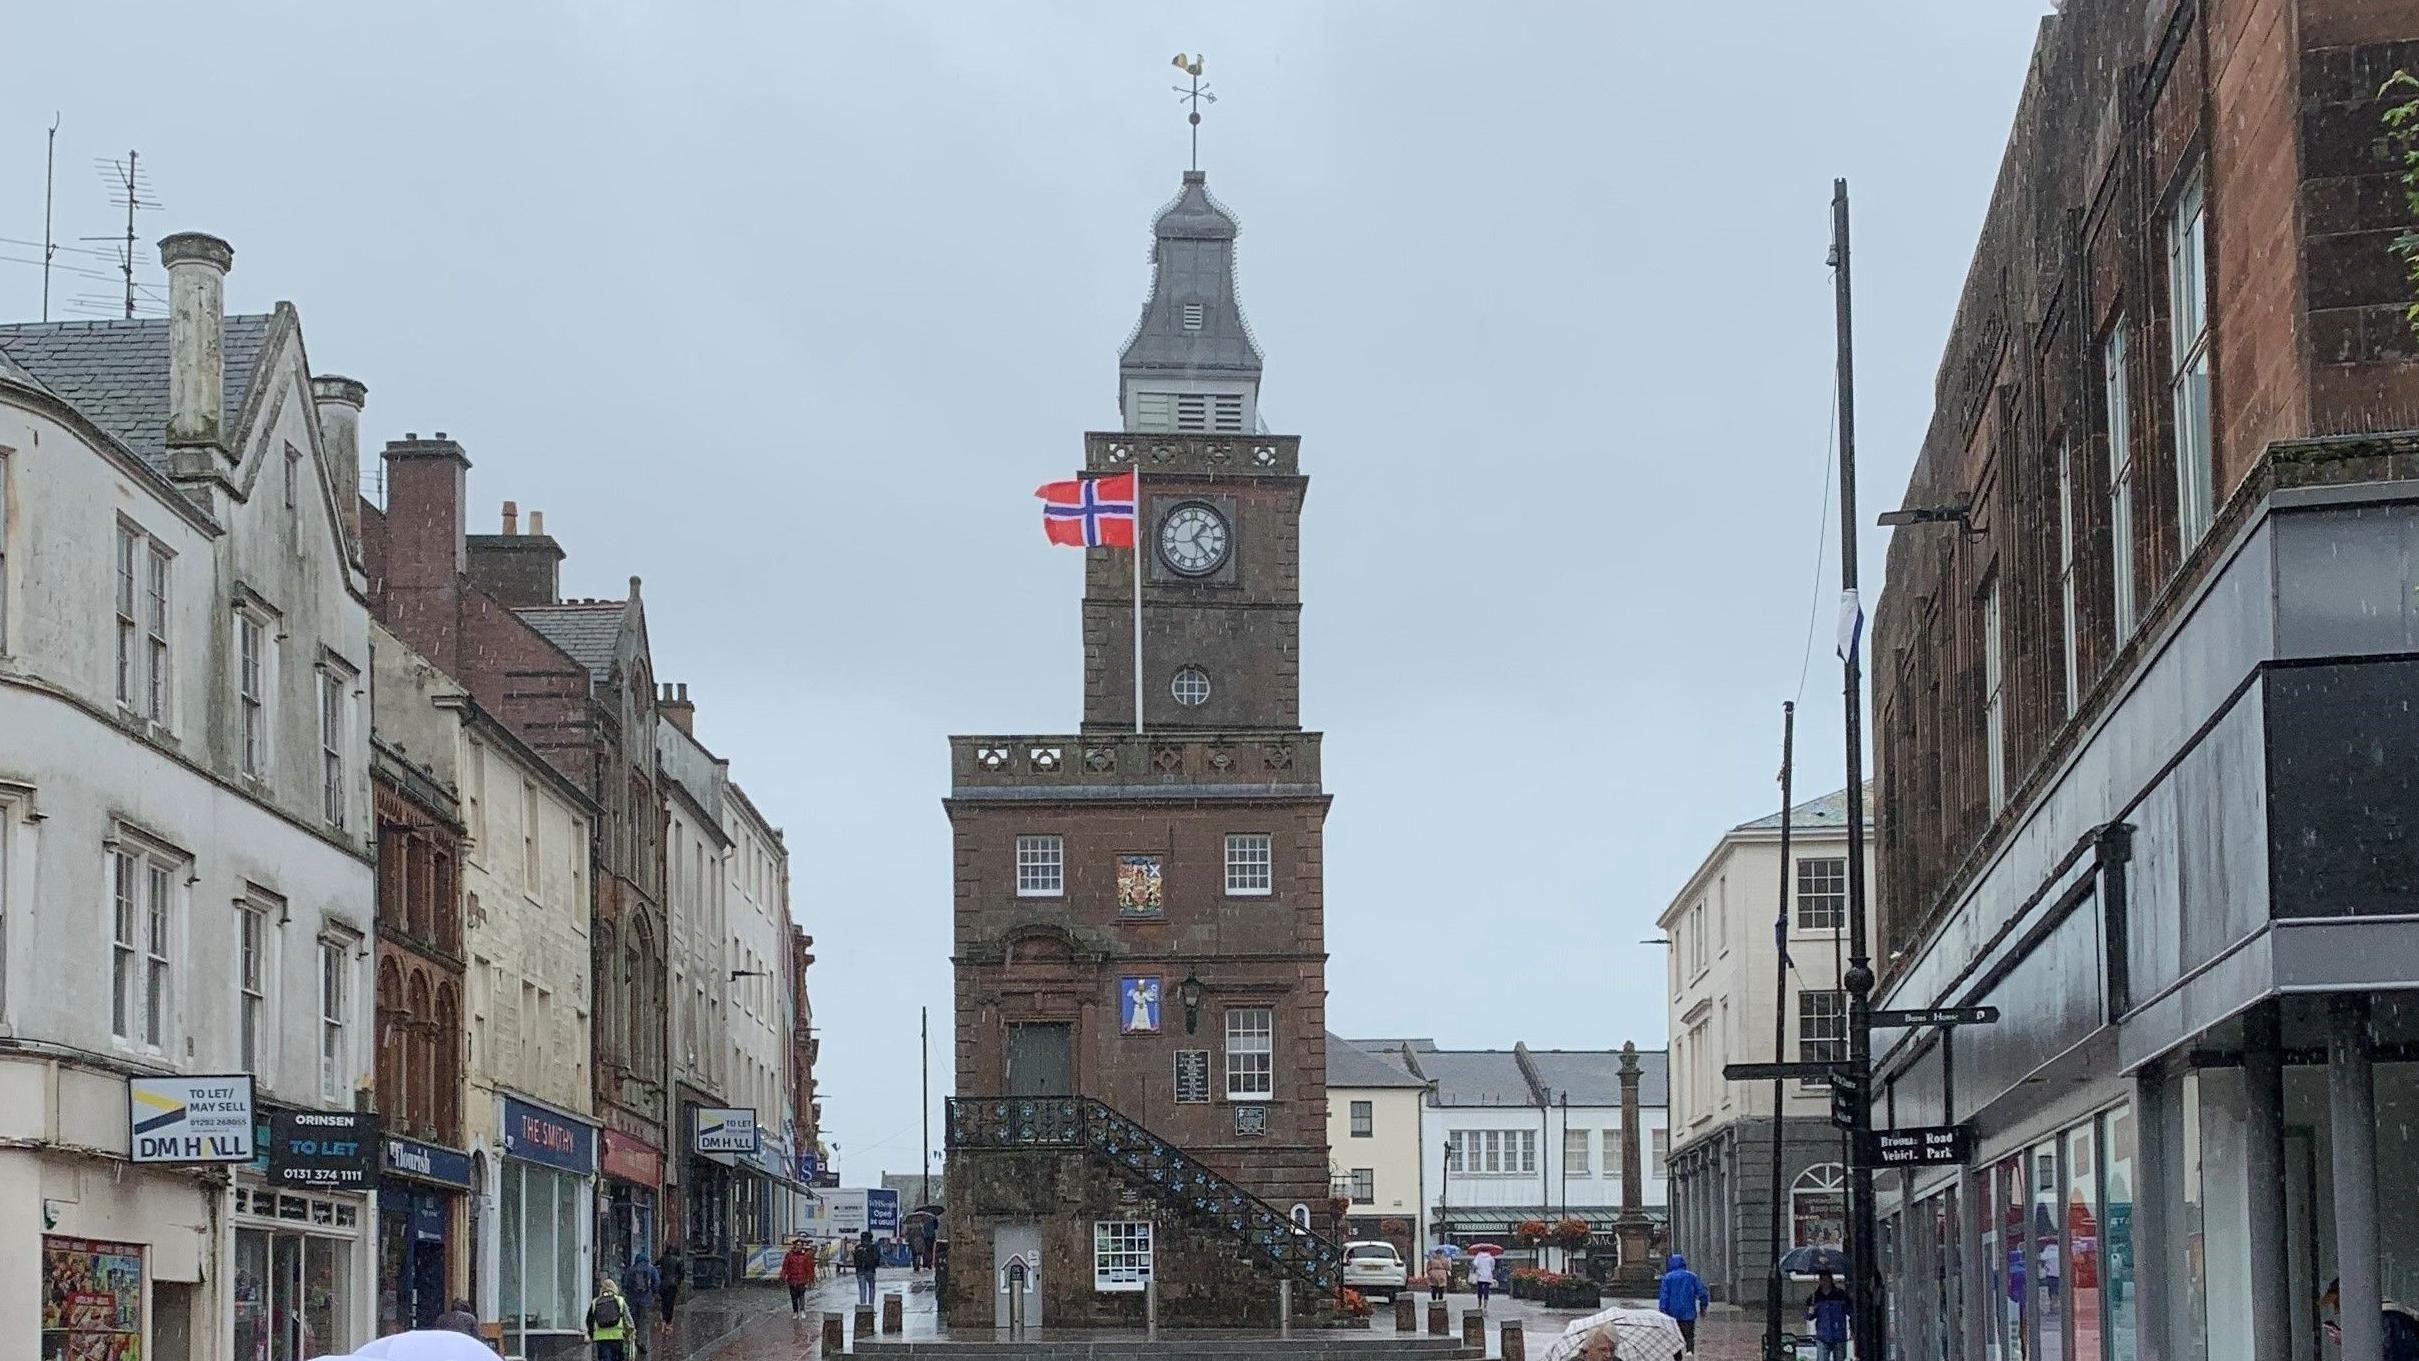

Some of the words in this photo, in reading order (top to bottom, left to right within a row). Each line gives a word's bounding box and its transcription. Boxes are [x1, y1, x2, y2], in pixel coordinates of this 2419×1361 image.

[189, 1089, 205, 1099] TO
[208, 1088, 234, 1099] LET/
[190, 1102, 215, 1112] MAY
[218, 1102, 246, 1112] SELL
[295, 1114, 354, 1127] ORINSEN
[521, 1114, 540, 1143] THE
[543, 1121, 574, 1153] SMITHY
[1926, 1133, 1953, 1144] Road
[140, 1137, 178, 1157] DM
[185, 1136, 247, 1157] HALL
[289, 1140, 317, 1154] TO
[321, 1141, 357, 1155] LET
[702, 1138, 720, 1148] DM
[1926, 1148, 1953, 1159] Park
[283, 1168, 311, 1179] 0131
[315, 1169, 338, 1180] 374
[341, 1170, 362, 1181] 1111
